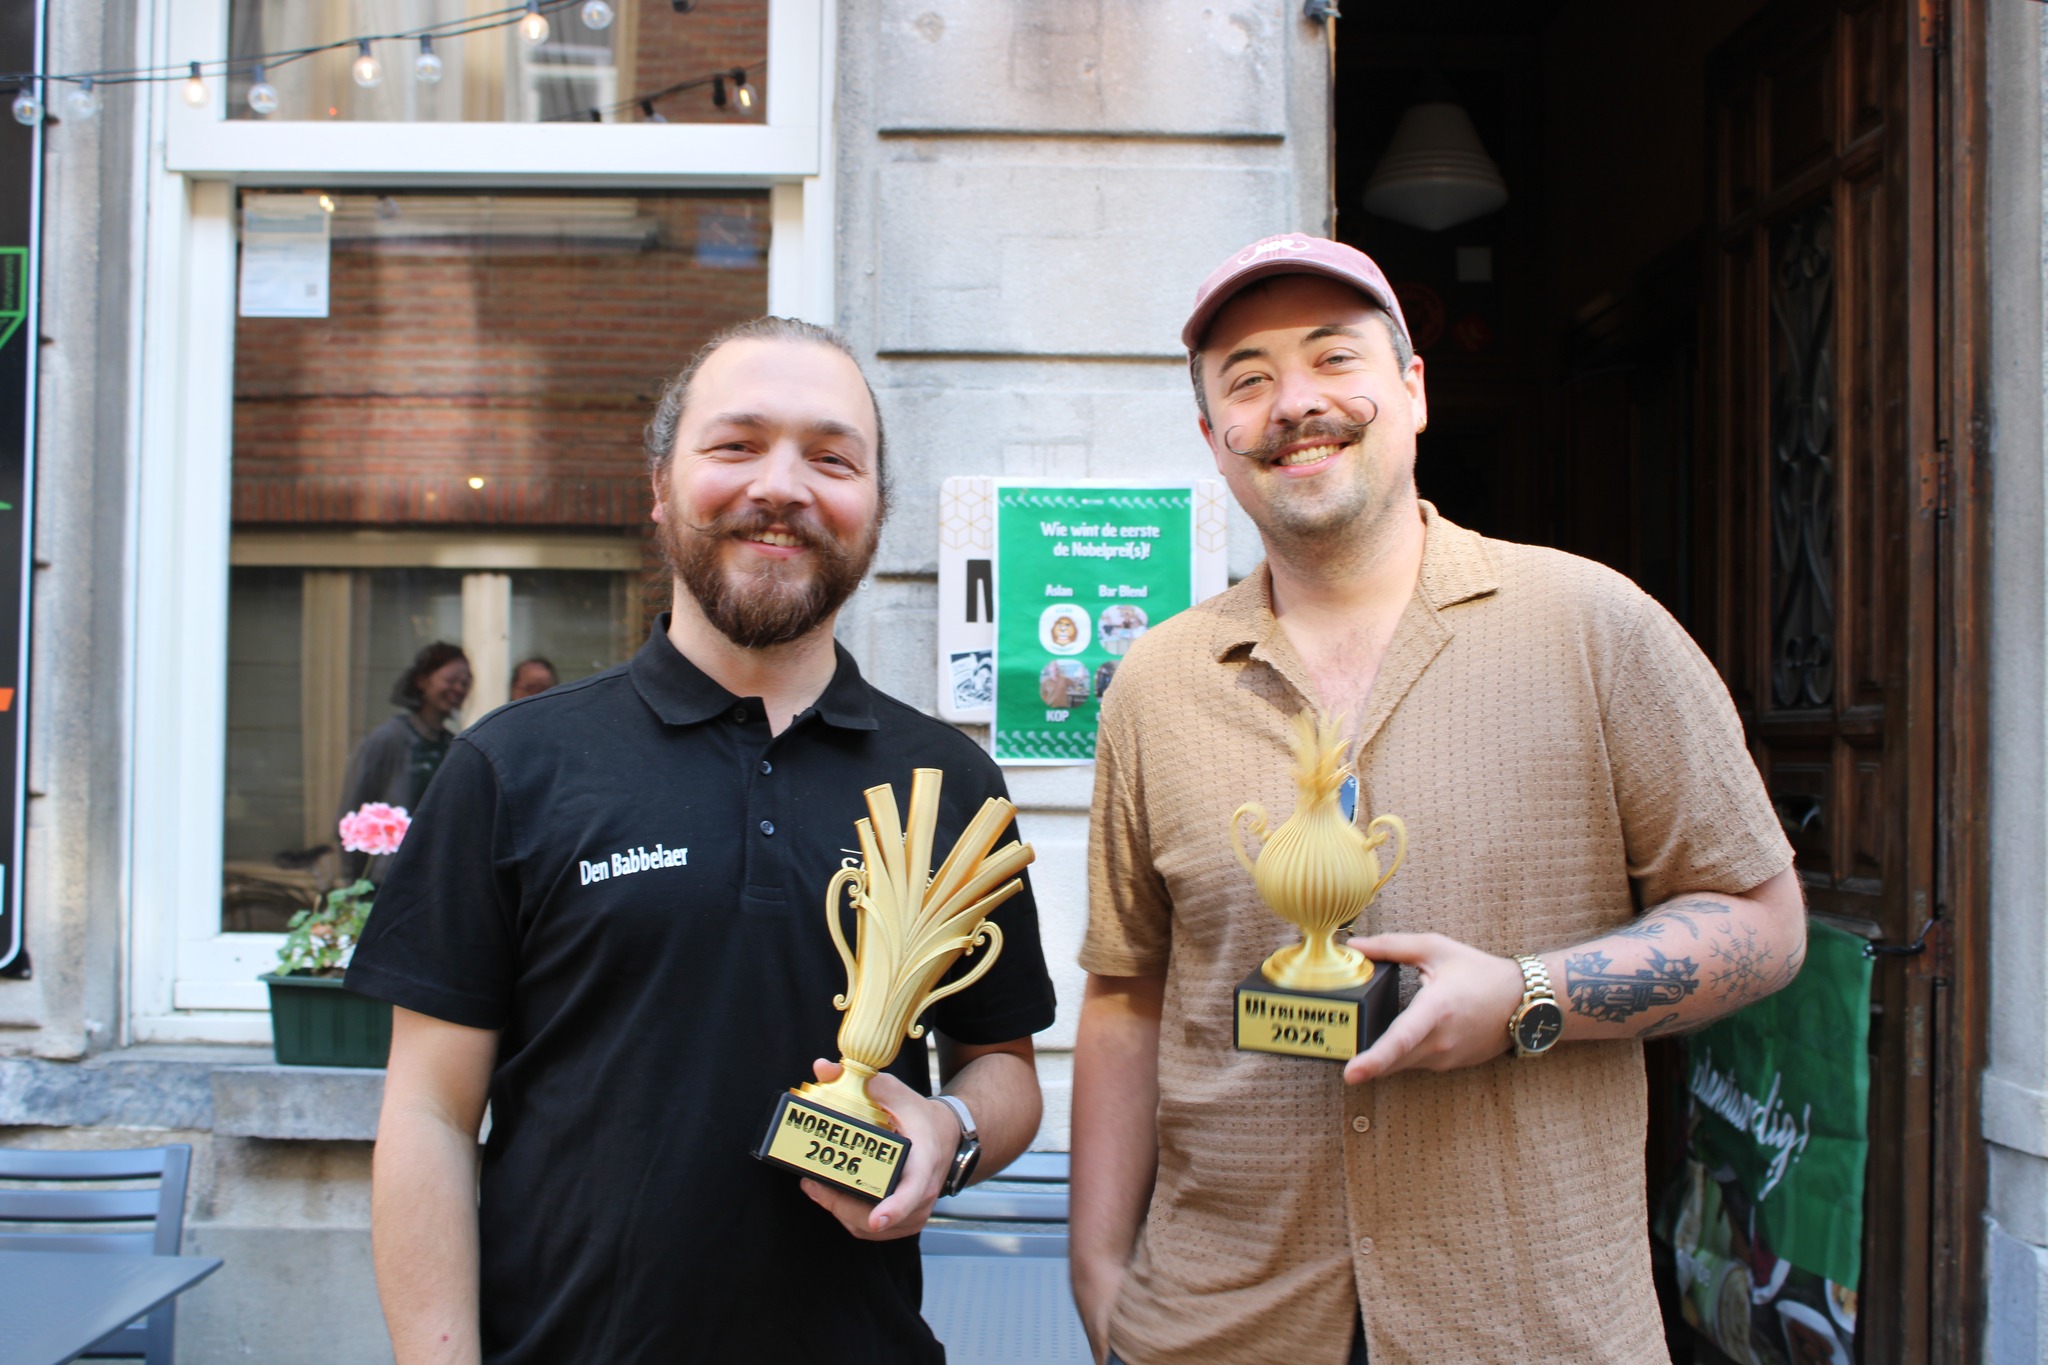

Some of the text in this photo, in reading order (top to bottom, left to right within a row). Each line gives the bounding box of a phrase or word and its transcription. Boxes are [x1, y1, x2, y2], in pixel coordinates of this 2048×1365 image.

[1040, 521, 1161, 538] Wie wint de eerste
[1053, 542, 1070, 556] de
[1098, 584, 1148, 598] Bar Blend
[1046, 710, 1070, 722] KOP
[579, 843, 689, 886] Den Babbelaer
[1271, 1023, 1326, 1047] 2026
[785, 1108, 898, 1165] NOBELPREI
[804, 1140, 863, 1176] 2026
